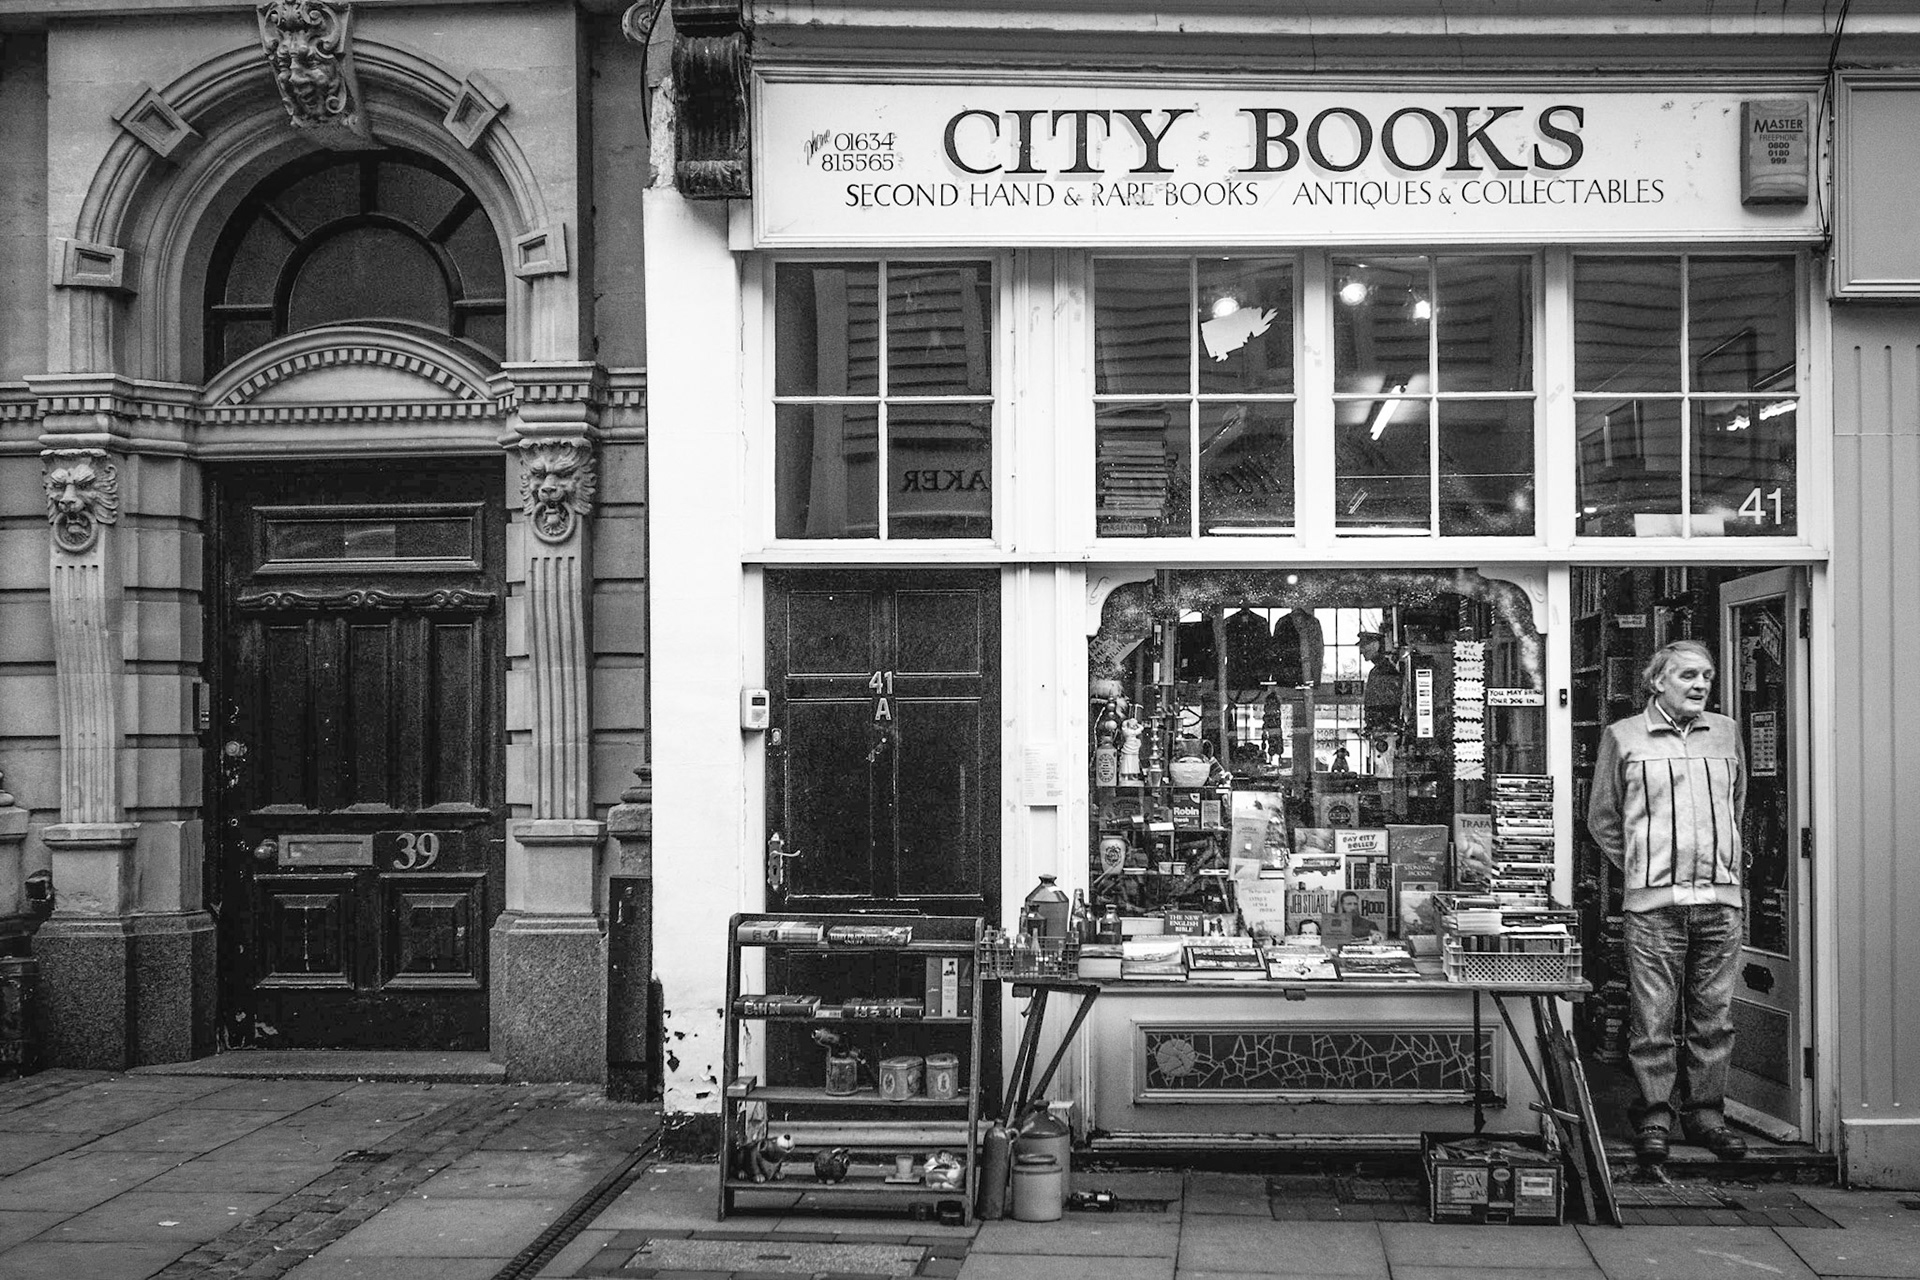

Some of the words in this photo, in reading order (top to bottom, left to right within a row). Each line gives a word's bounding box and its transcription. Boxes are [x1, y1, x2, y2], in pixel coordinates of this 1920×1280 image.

[1753, 119, 1804, 133] MASTER
[834, 132, 895, 151] 01634
[943, 109, 1194, 174] CITY
[1240, 105, 1585, 173] BOOKS
[821, 153, 894, 171] 815565
[845, 183, 959, 207] SECOND
[970, 182, 1055, 207] HAND
[1063, 187, 1081, 207] &
[1092, 182, 1154, 206] RARE
[1165, 182, 1259, 206] BOOKS
[1293, 181, 1432, 210] ANTIQUES
[1439, 187, 1452, 205] &
[1462, 179, 1665, 204] COLLECTABLES
[1737, 487, 1783, 525] 41
[868, 671, 893, 695] 41
[874, 697, 892, 721] A
[1509, 697, 1523, 705] DOG
[1173, 806, 1200, 816] Robin
[393, 832, 440, 870] 39
[1289, 894, 1303, 914] JEB
[1303, 894, 1329, 914] STUART
[1361, 899, 1385, 916] HOOD
